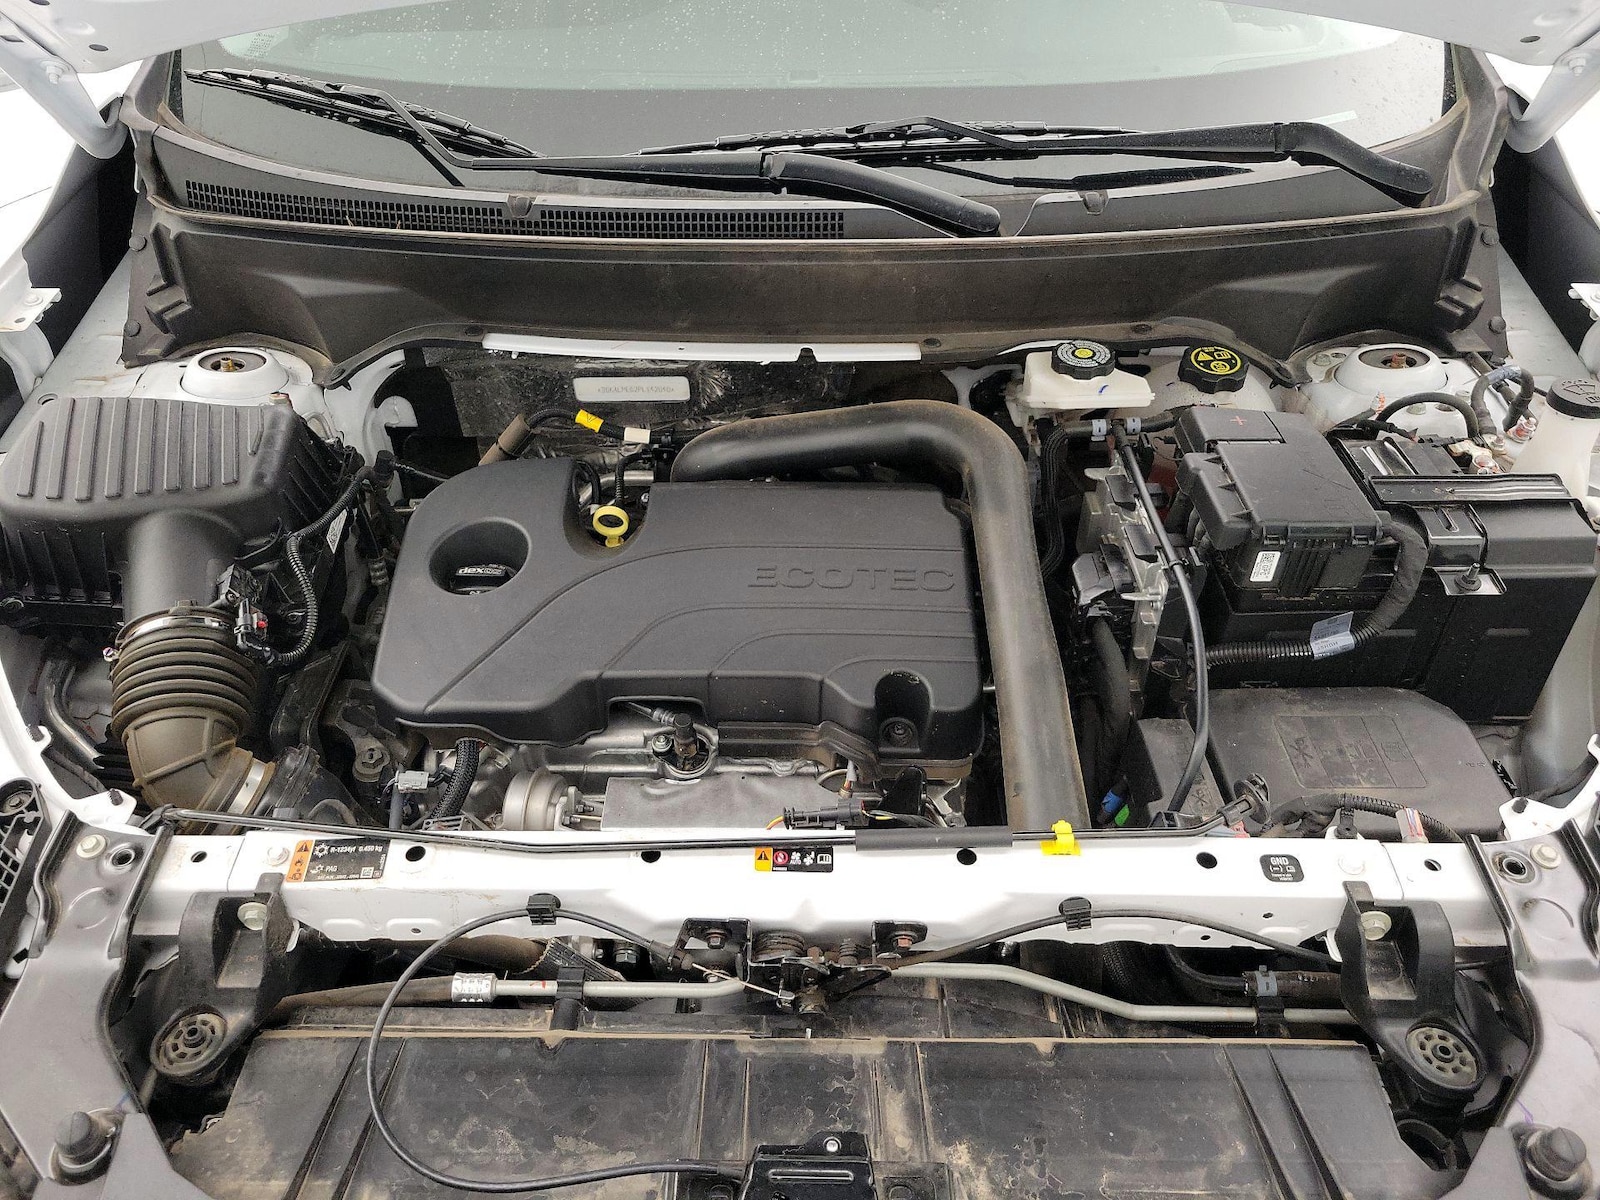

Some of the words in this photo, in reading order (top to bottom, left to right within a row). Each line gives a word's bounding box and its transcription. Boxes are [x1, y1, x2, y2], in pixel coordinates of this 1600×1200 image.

[458, 566, 503, 576] dexos
[748, 566, 955, 593] ECOTEC
[330, 846, 357, 854] R-1234yf
[358, 845, 375, 853] 0.450
[375, 845, 383, 853] kg
[1271, 857, 1289, 866] GND
